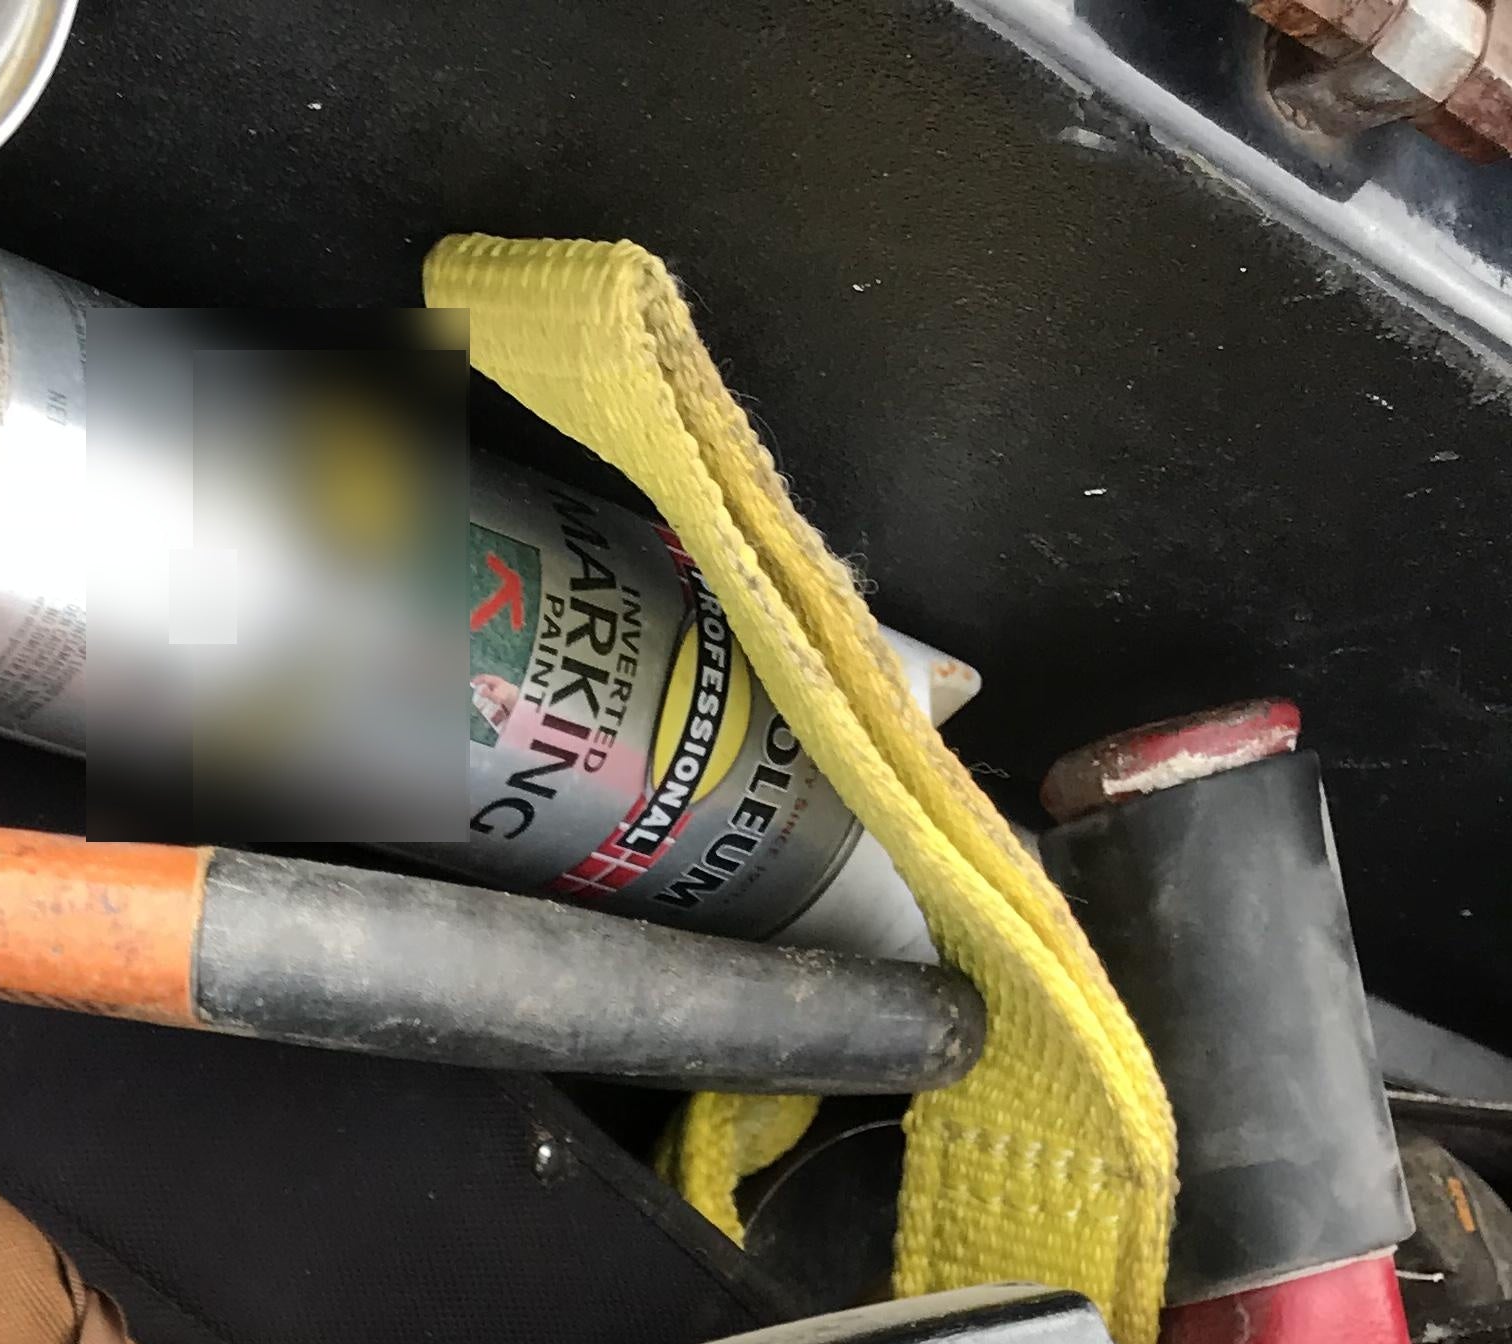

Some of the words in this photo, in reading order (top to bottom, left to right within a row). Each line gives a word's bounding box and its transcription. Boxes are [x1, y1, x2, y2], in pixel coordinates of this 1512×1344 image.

[470, 488, 619, 841] MARKING
[525, 593, 566, 715] PAINT
[583, 585, 641, 774] INVERTED
[625, 567, 730, 848] PROFESSIONAL
